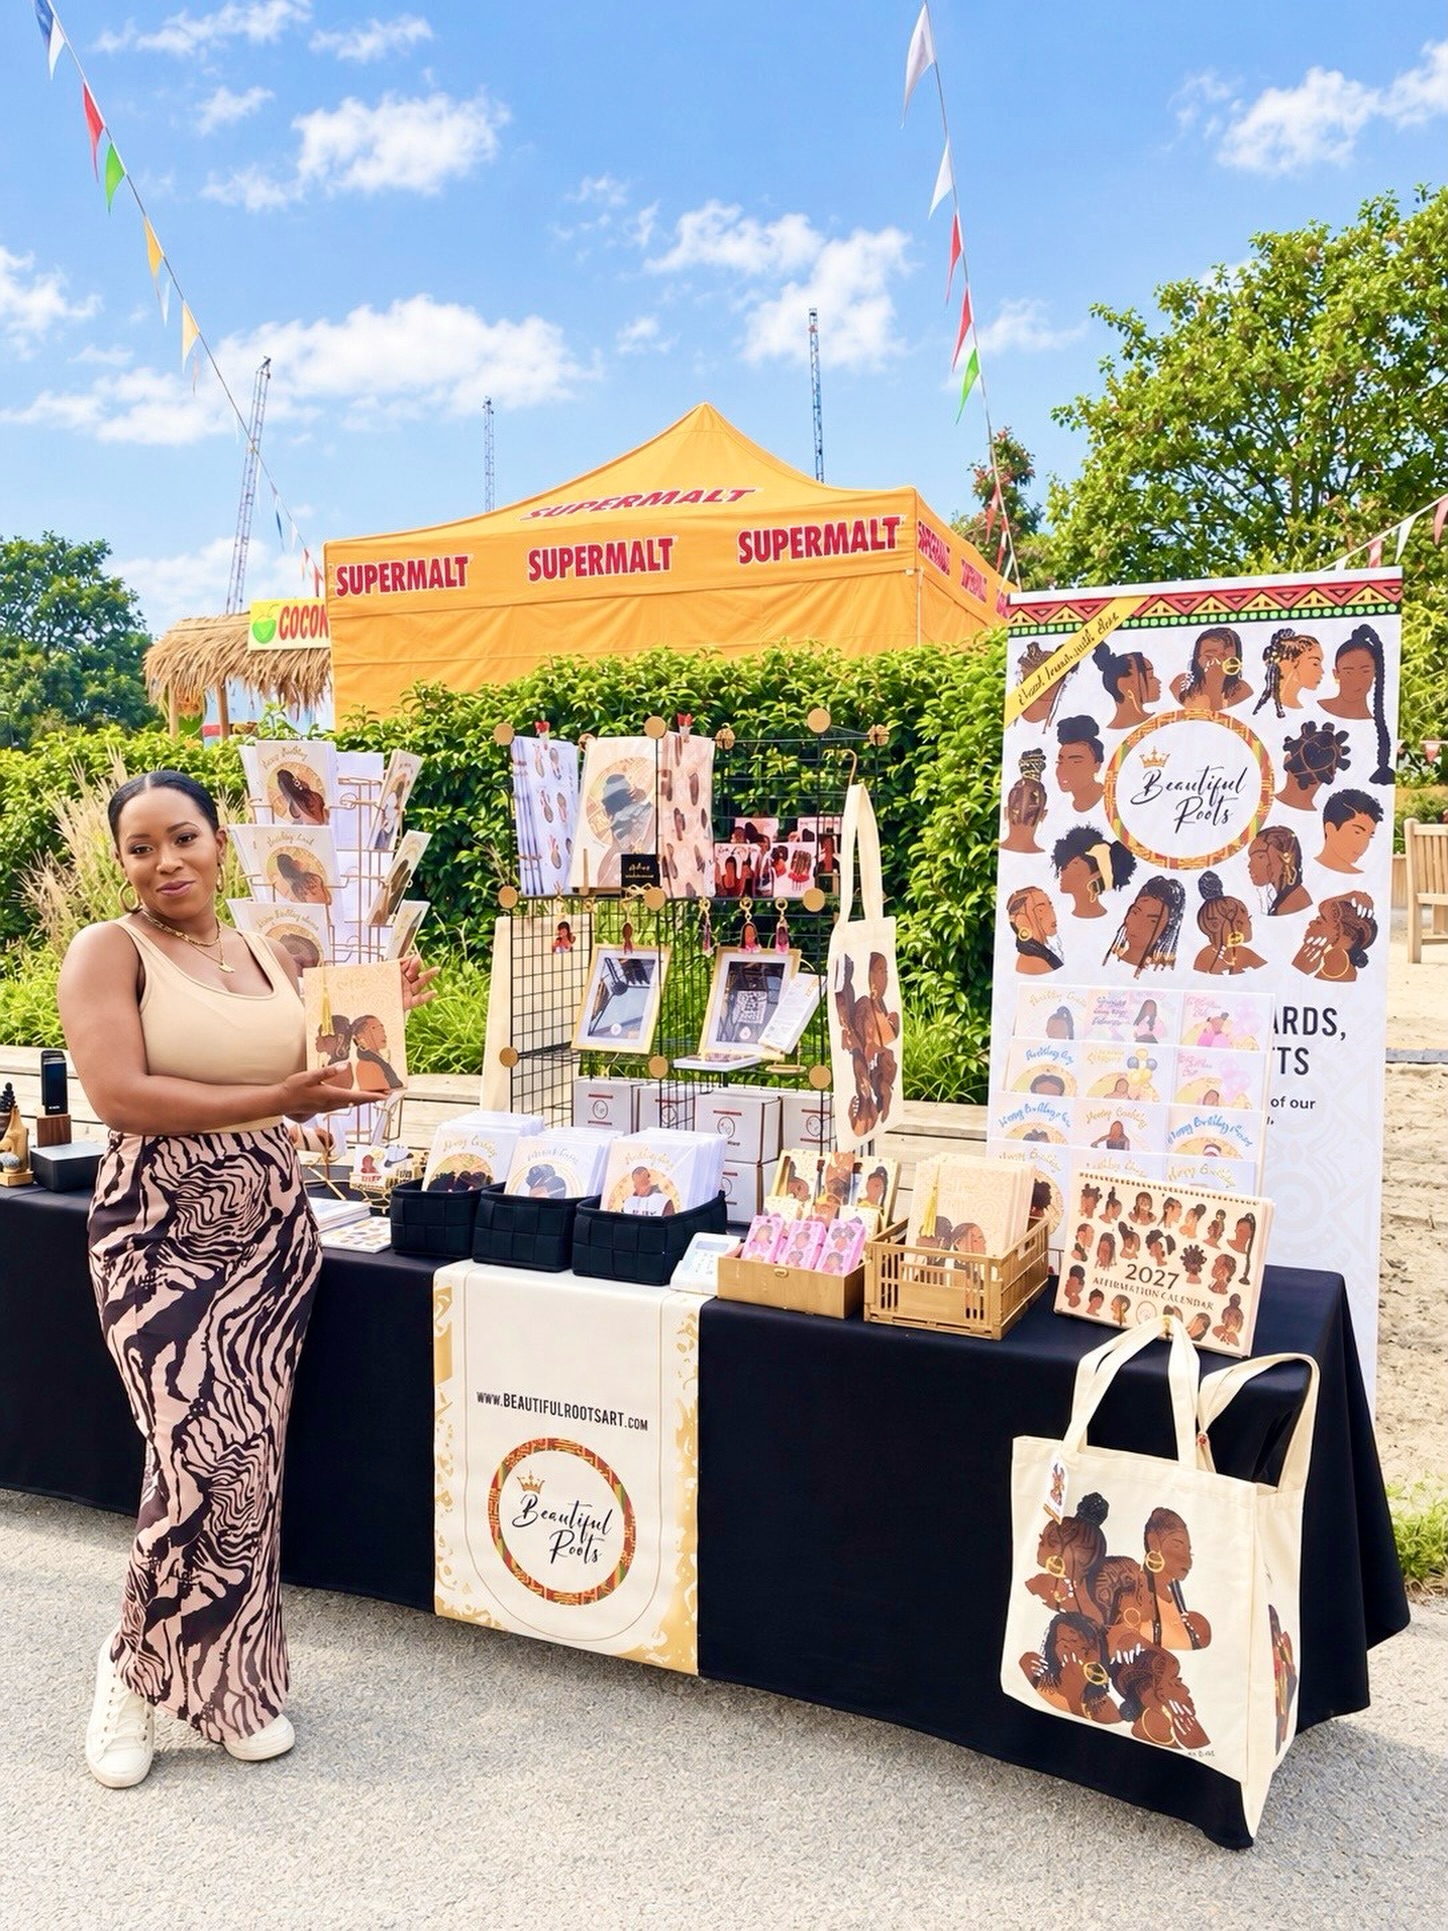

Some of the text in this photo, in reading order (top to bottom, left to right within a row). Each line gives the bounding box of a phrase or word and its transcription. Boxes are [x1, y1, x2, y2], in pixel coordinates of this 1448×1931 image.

[521, 489, 757, 519] SUPERMALT
[528, 537, 674, 581] SUPERMALT
[738, 516, 900, 564] SUPERMALT
[336, 556, 469, 596] SUPERMALT
[1130, 765, 1248, 807] Beautiful
[1174, 796, 1239, 834] Roots
[1273, 1046, 1310, 1075] TS
[1270, 1095, 1316, 1109] of our
[1125, 1264, 1179, 1289] 2027
[477, 1392, 648, 1431] WWW.BEAUTIFULROOTSART.COM
[512, 1493, 613, 1544] Beautiful
[549, 1529, 606, 1565] Roots
